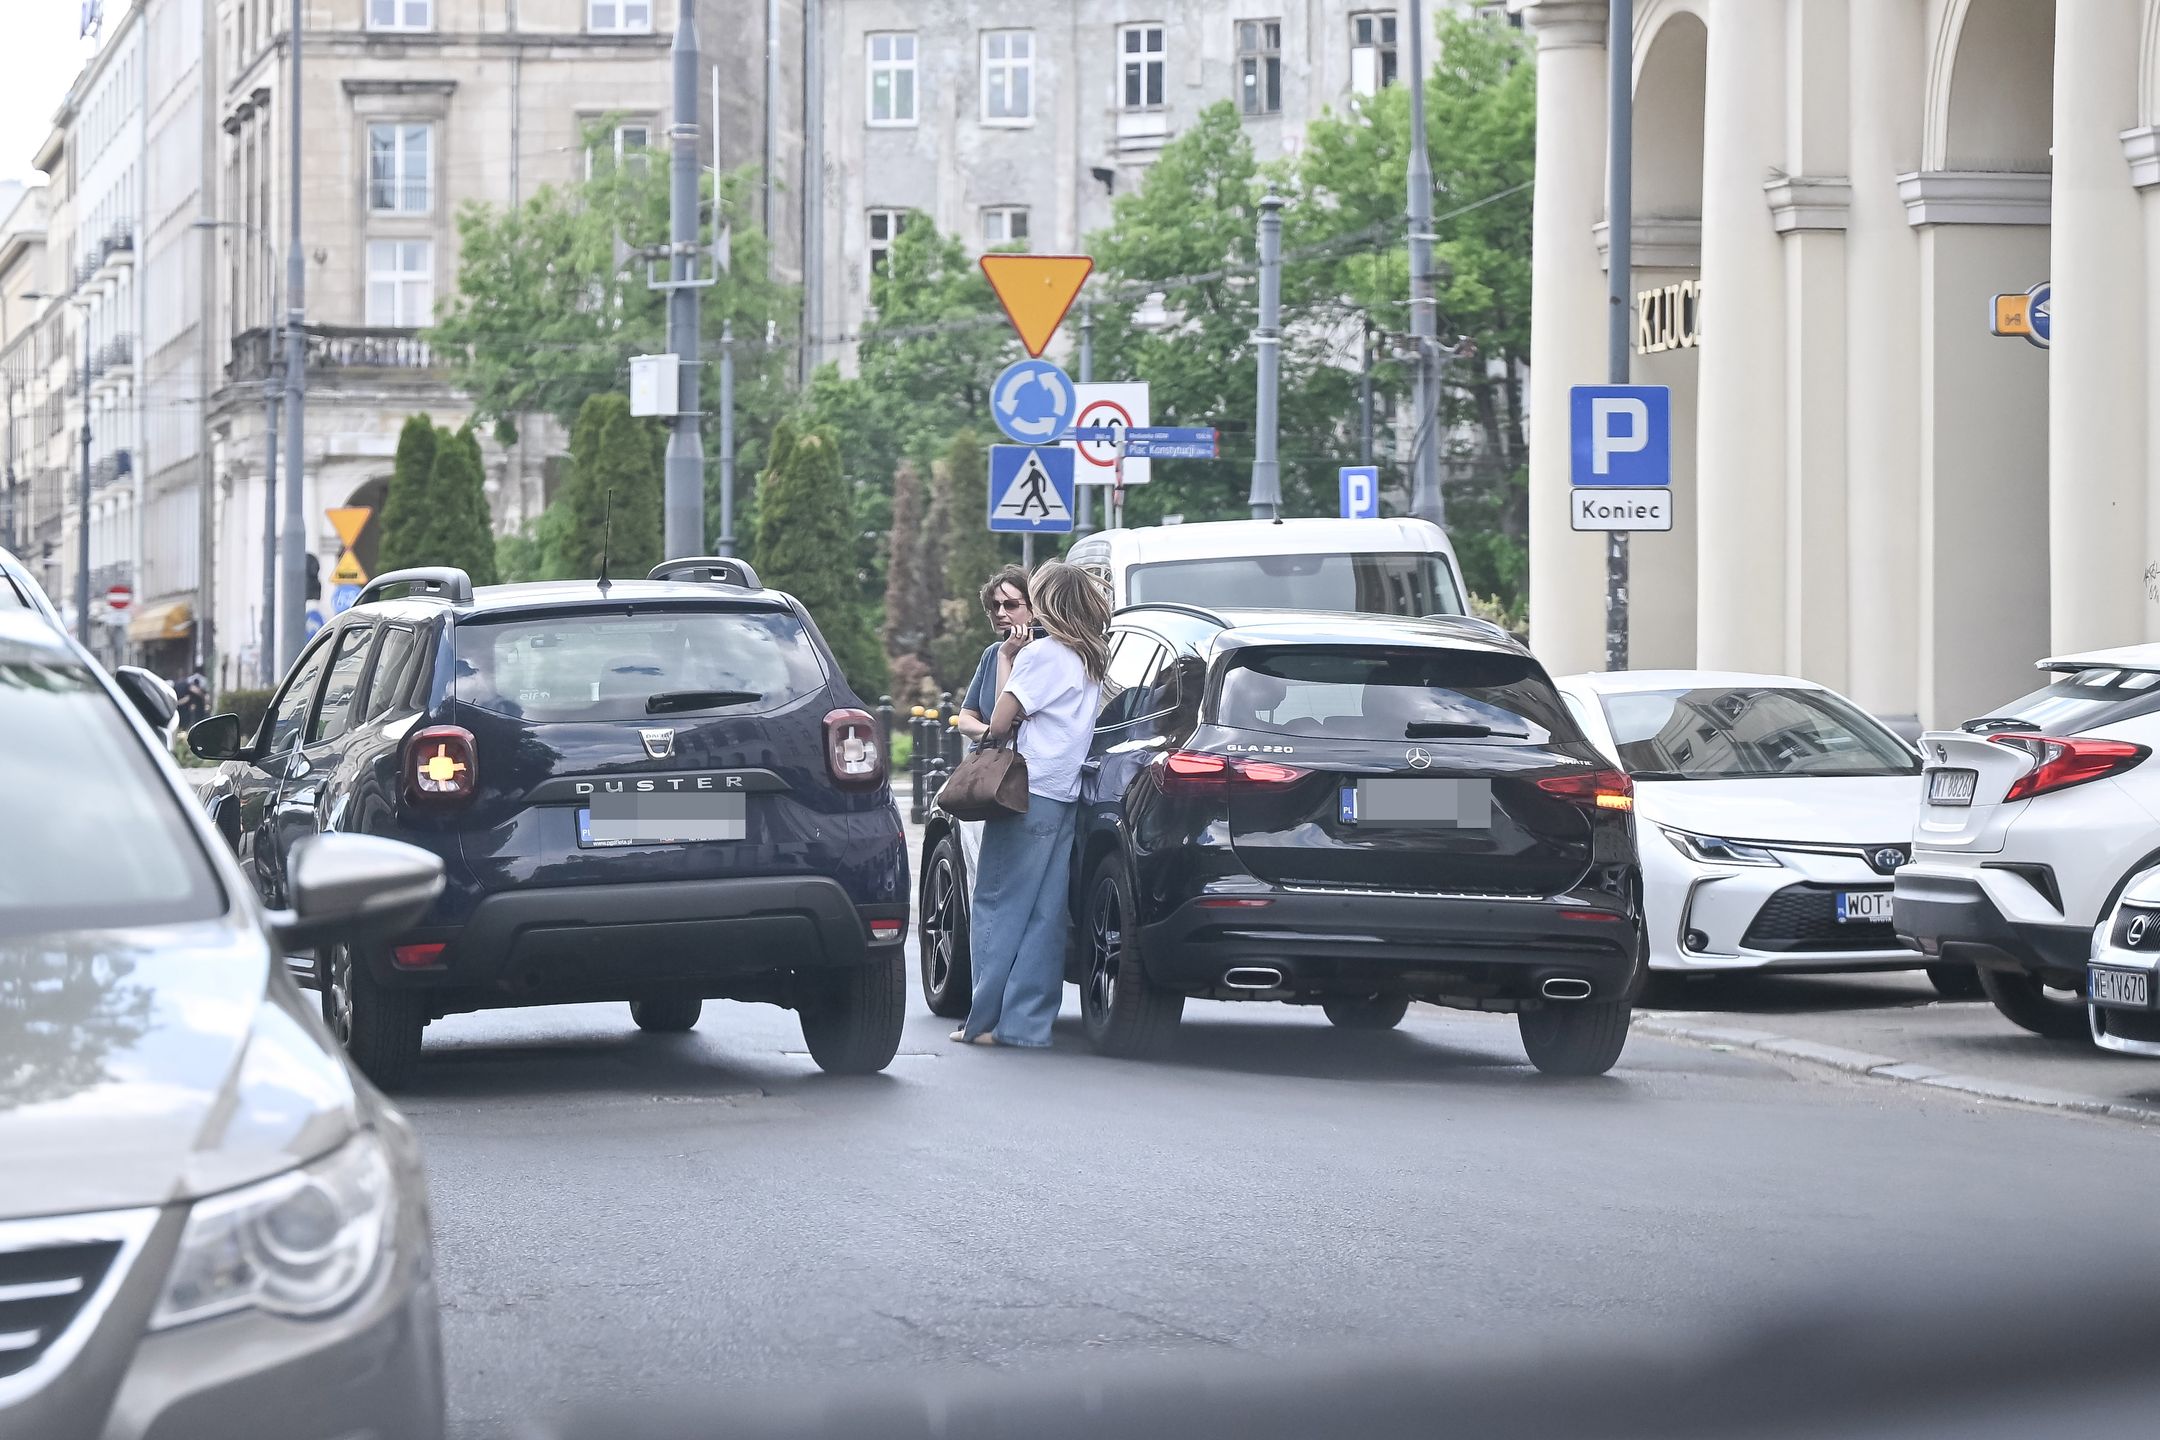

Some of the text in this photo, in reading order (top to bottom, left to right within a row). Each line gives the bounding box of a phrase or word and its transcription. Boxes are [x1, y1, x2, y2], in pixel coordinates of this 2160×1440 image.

[1592, 397, 1649, 474] P
[1348, 474, 1370, 518] P
[1582, 500, 1660, 519] Koniec
[1226, 744, 1294, 754] GLA 220
[575, 776, 743, 795] DUSTER
[1848, 894, 1884, 915] WOT
[2110, 973, 2146, 1003] 1V670
